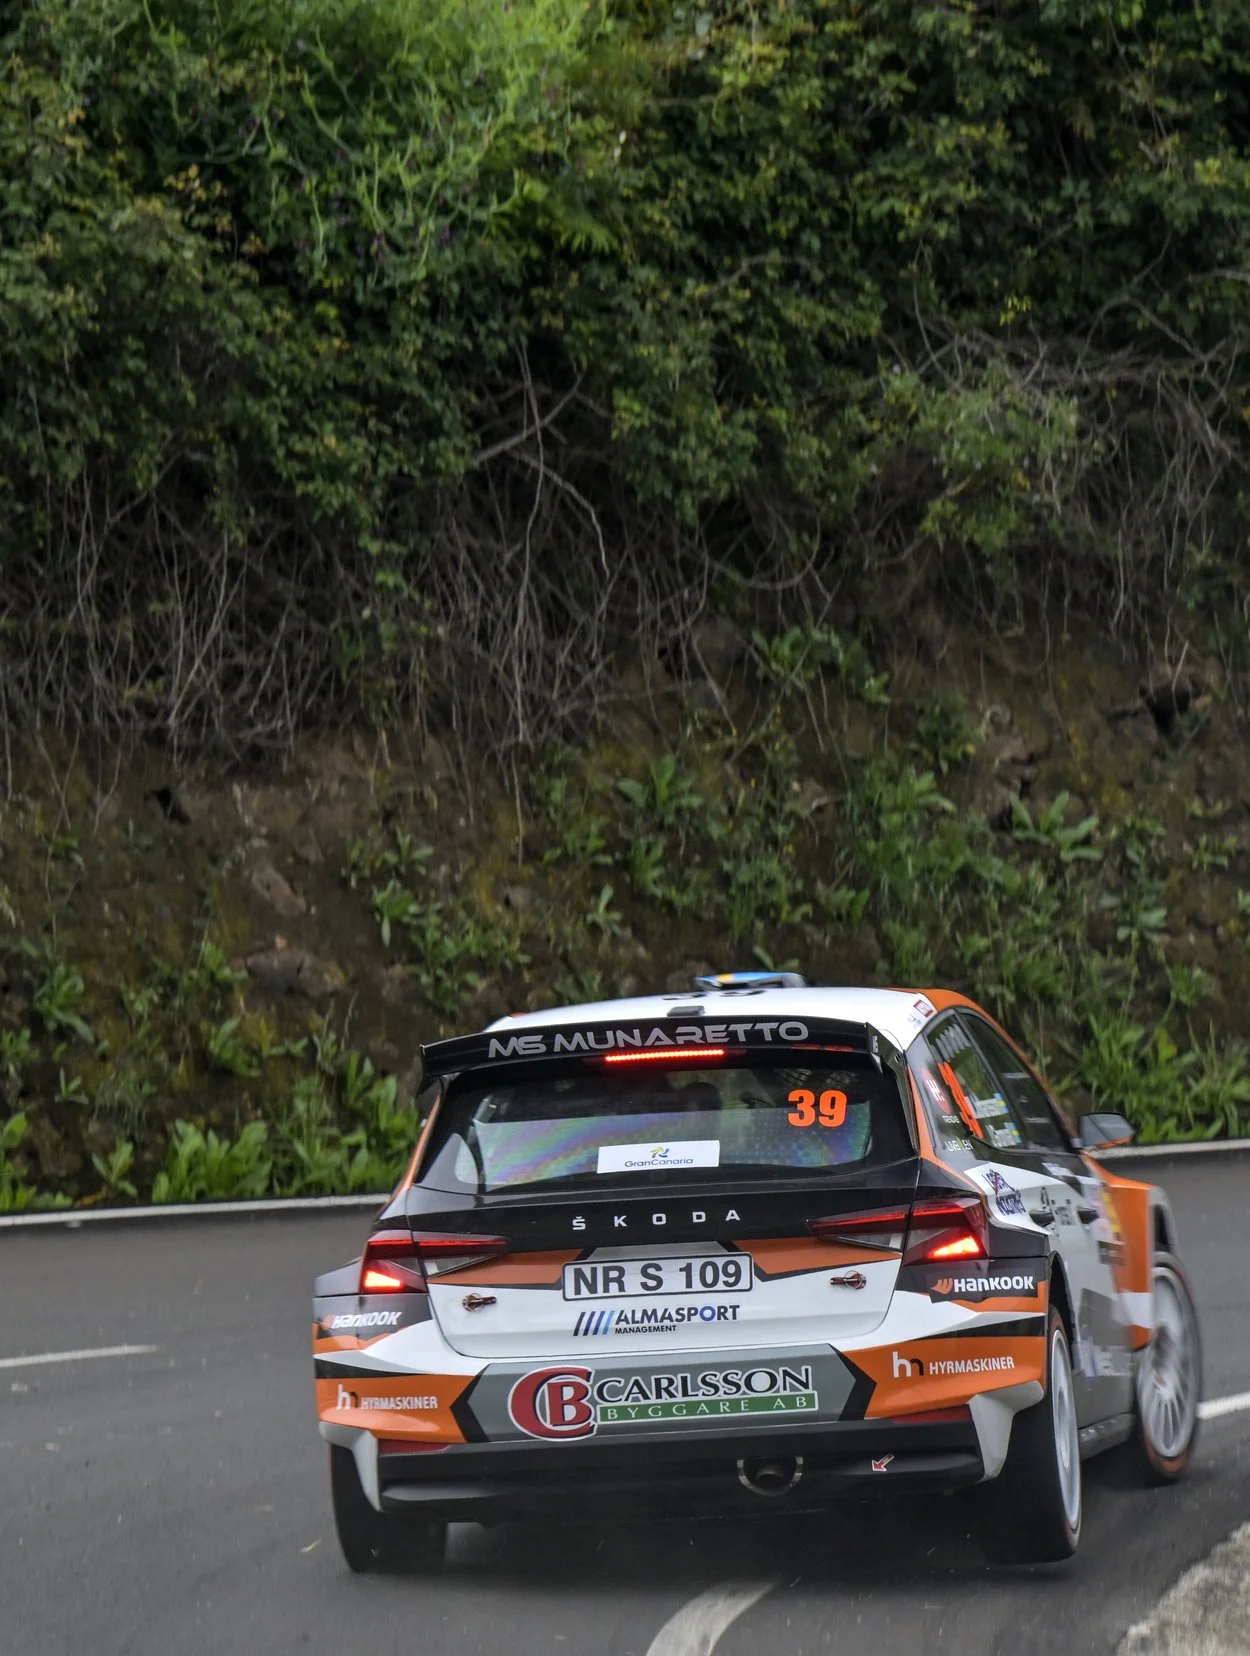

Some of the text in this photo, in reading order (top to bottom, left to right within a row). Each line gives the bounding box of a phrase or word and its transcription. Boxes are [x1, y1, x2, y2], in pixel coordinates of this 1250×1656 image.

[487, 1021, 809, 1058] MS MUNARETTO
[787, 1089, 848, 1127] 39
[624, 1156, 694, 1168] GranCanaria
[572, 1208, 741, 1231] ŠKODA
[573, 1260, 742, 1296] NR S 109
[614, 1305, 740, 1326] ALMASPORT
[614, 1325, 677, 1335] MANAGEMENT
[929, 1356, 1015, 1376] HYRMASKINER
[595, 1367, 811, 1403] CARLSSON
[607, 1396, 808, 1420] BYGGARE AB
